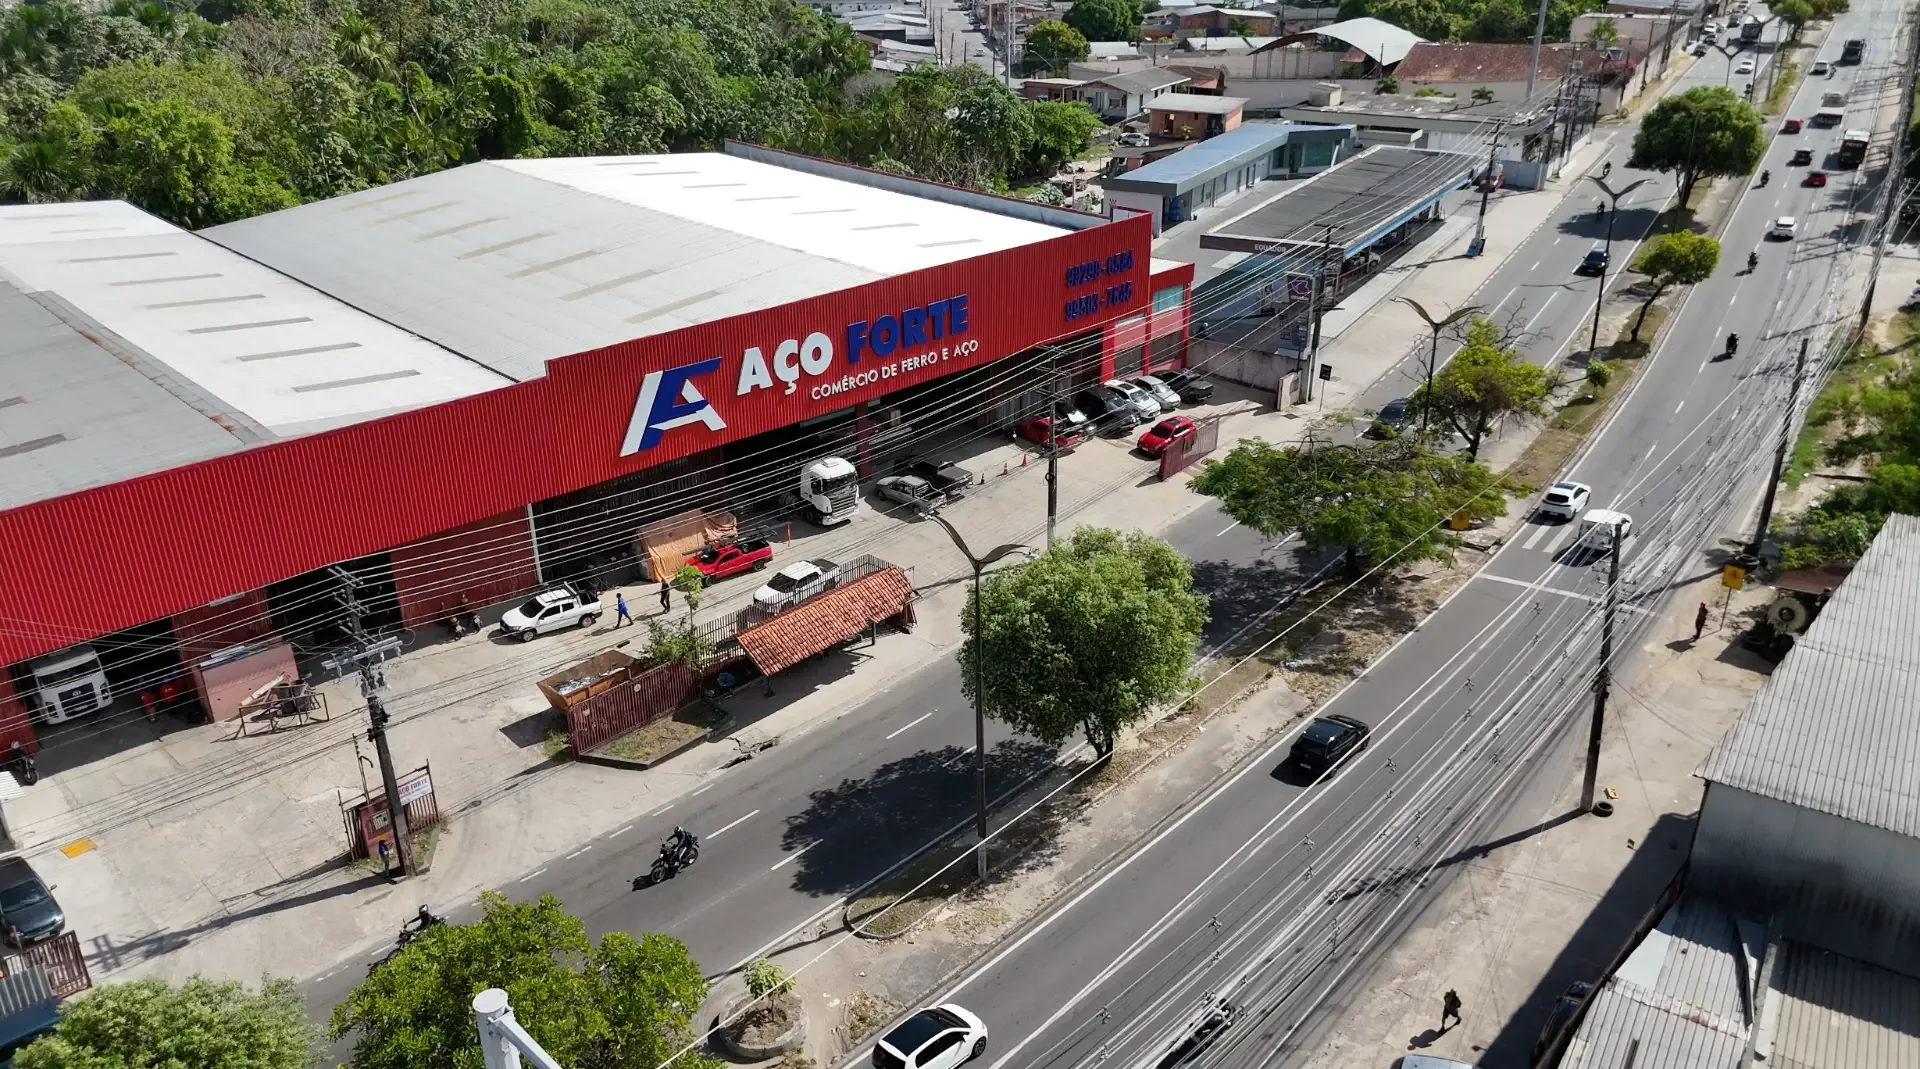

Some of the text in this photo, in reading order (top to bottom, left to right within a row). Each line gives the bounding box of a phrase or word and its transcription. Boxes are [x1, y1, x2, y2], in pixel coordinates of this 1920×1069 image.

[737, 293, 969, 396] AÇO FORTE
[811, 340, 979, 401] COMÉRCIO DE FERRO E AÇO
